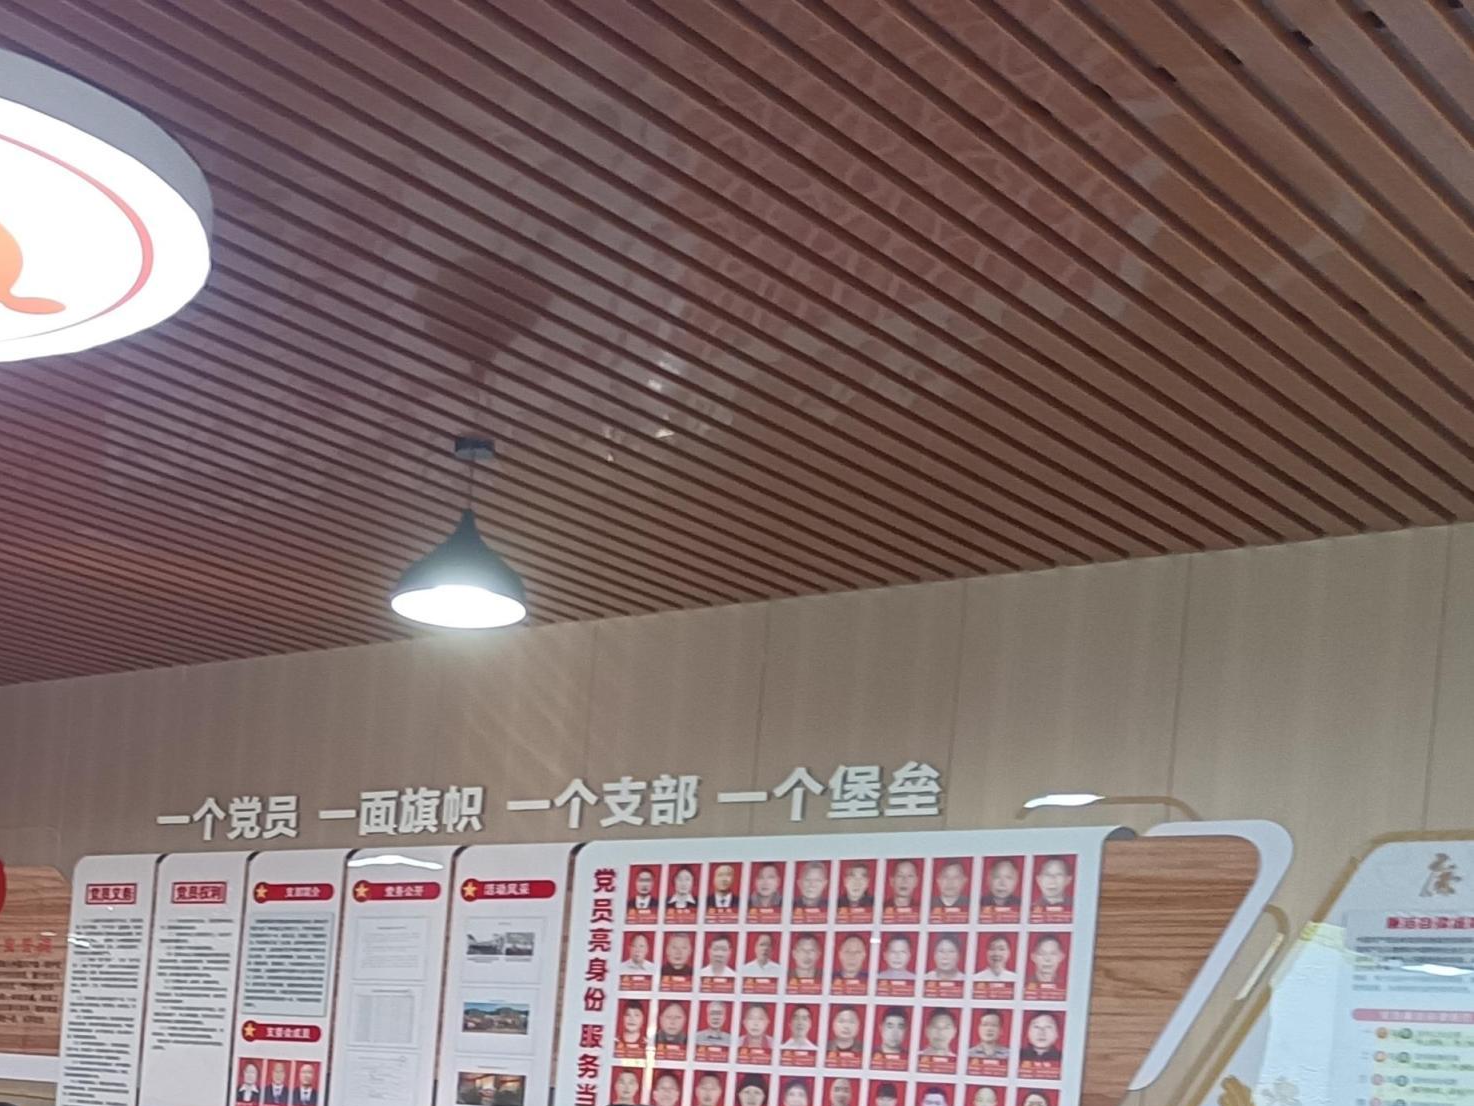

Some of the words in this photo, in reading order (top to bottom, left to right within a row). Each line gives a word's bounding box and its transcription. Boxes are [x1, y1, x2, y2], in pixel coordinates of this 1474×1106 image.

[157, 795, 298, 841] 一个党员
[319, 785, 484, 836] 一面旗帜
[506, 774, 701, 829] 一个支部
[717, 760, 942, 822] 一个堡垒
[584, 867, 618, 1012] 党员亮身份
